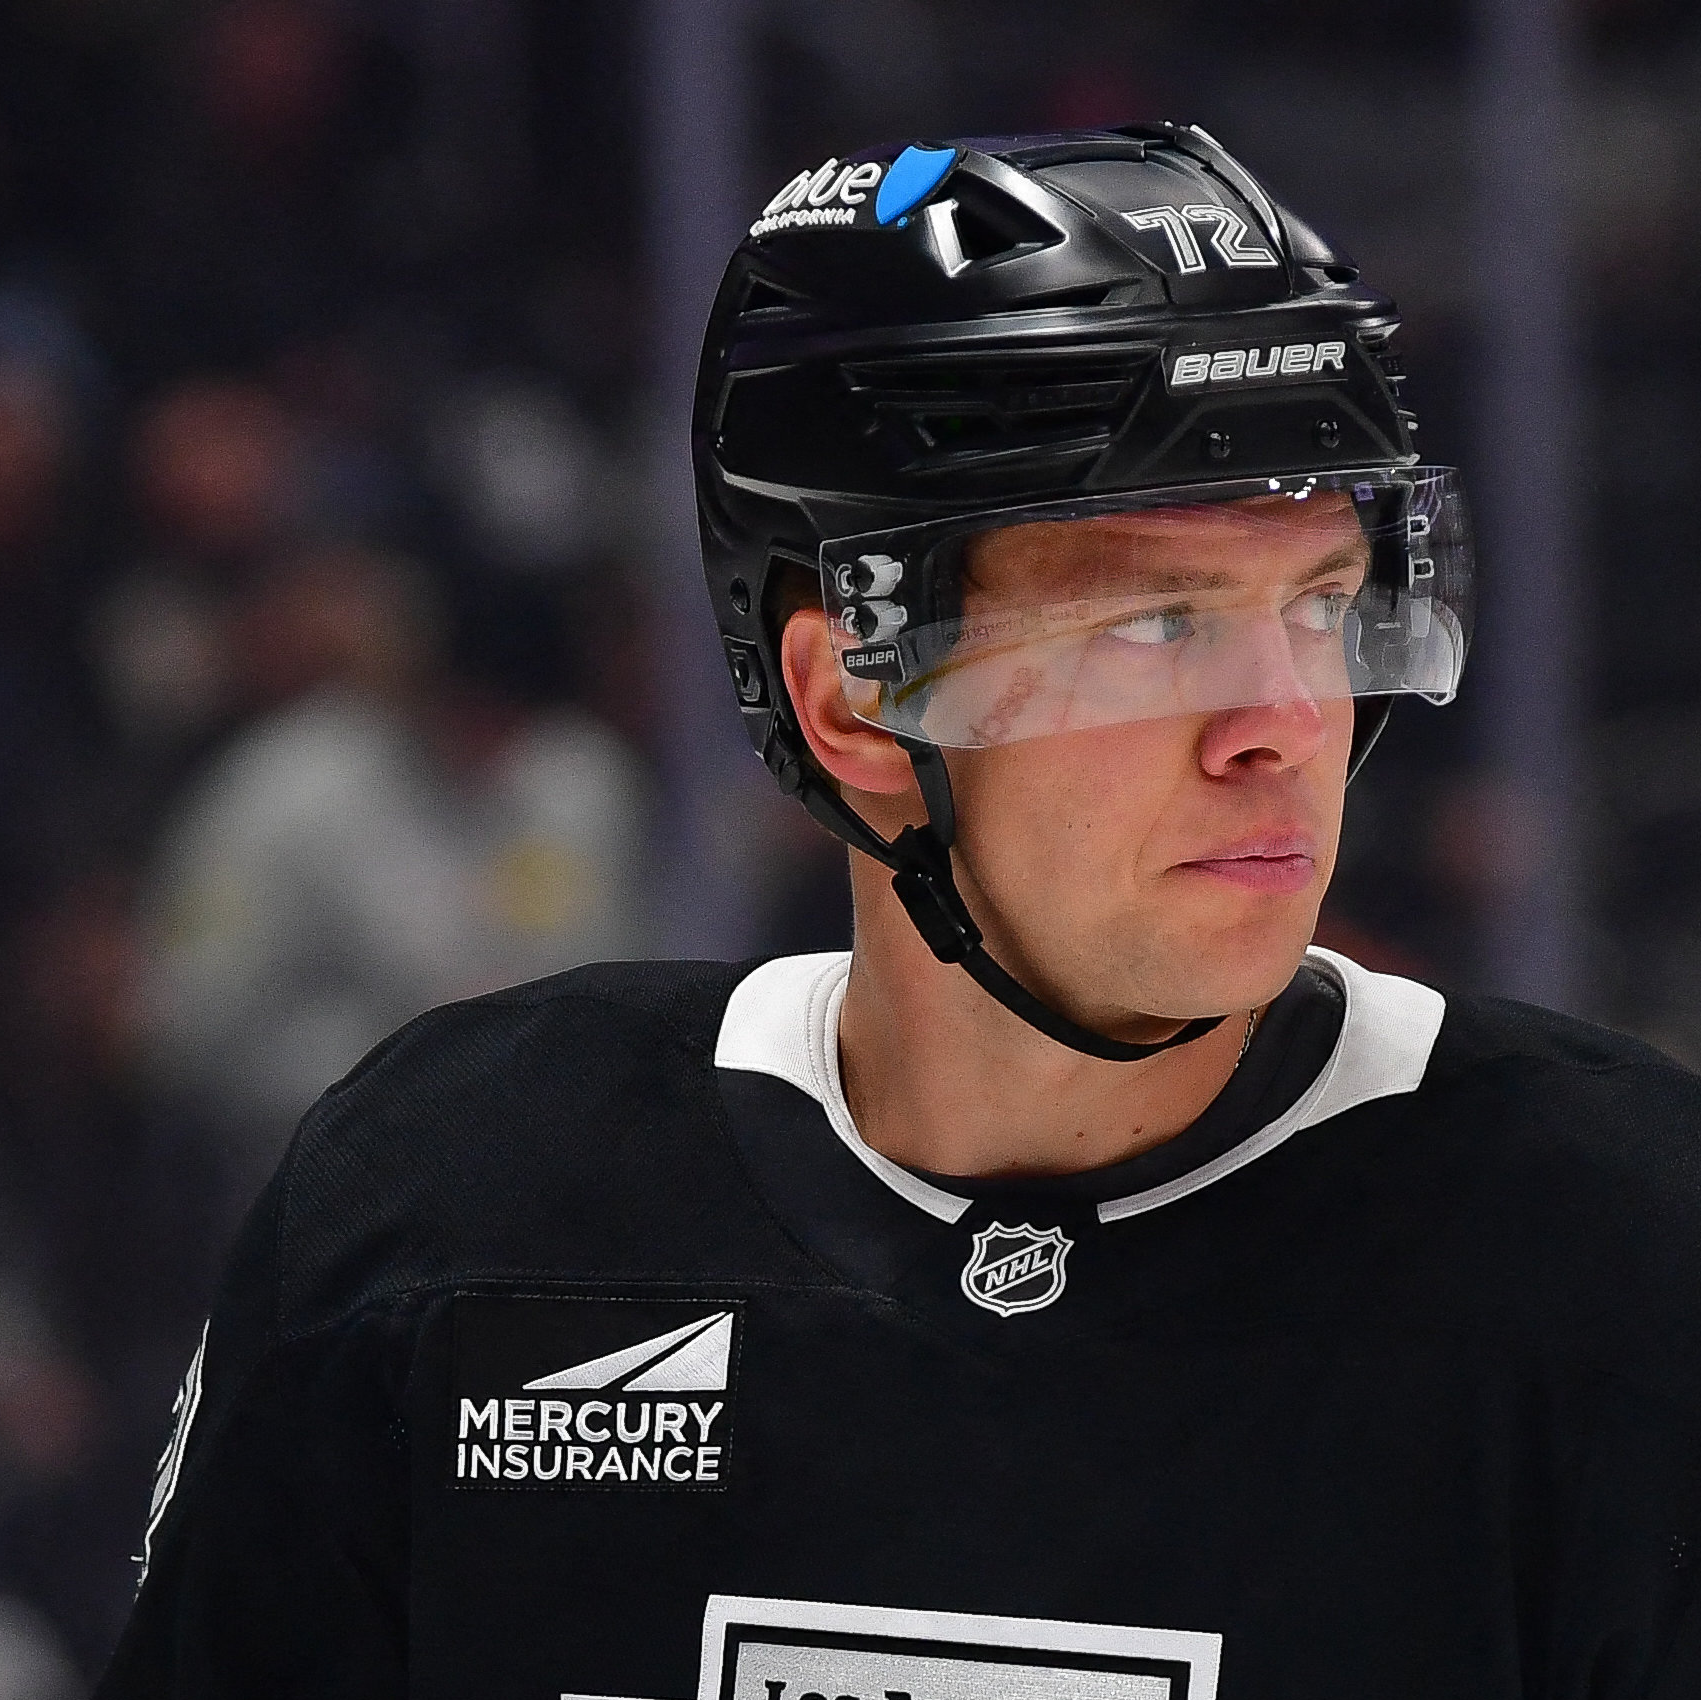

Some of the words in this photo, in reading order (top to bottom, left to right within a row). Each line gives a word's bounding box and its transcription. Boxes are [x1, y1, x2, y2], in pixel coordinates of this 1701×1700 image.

[1121, 203, 1279, 275] 72
[1170, 341, 1346, 386] BAUER
[845, 650, 896, 668] BAUER
[984, 1249, 1049, 1291] NHL
[458, 1398, 724, 1443] MERCURY
[456, 1444, 722, 1482] INSURANCE
